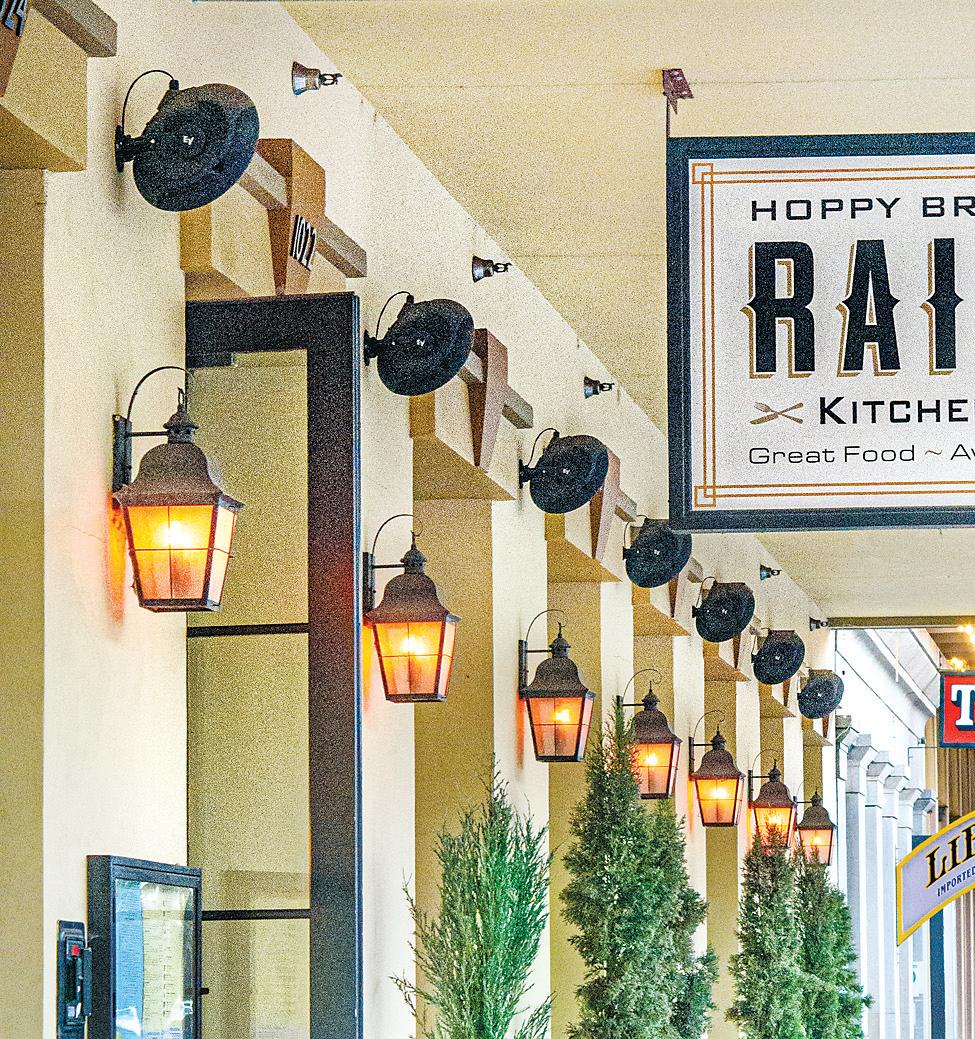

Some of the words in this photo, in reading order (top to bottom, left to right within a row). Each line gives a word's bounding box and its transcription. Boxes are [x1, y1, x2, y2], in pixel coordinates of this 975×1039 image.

[751, 197, 901, 221] HOPPY
[749, 447, 836, 465] Great
[844, 445, 916, 463] Food
